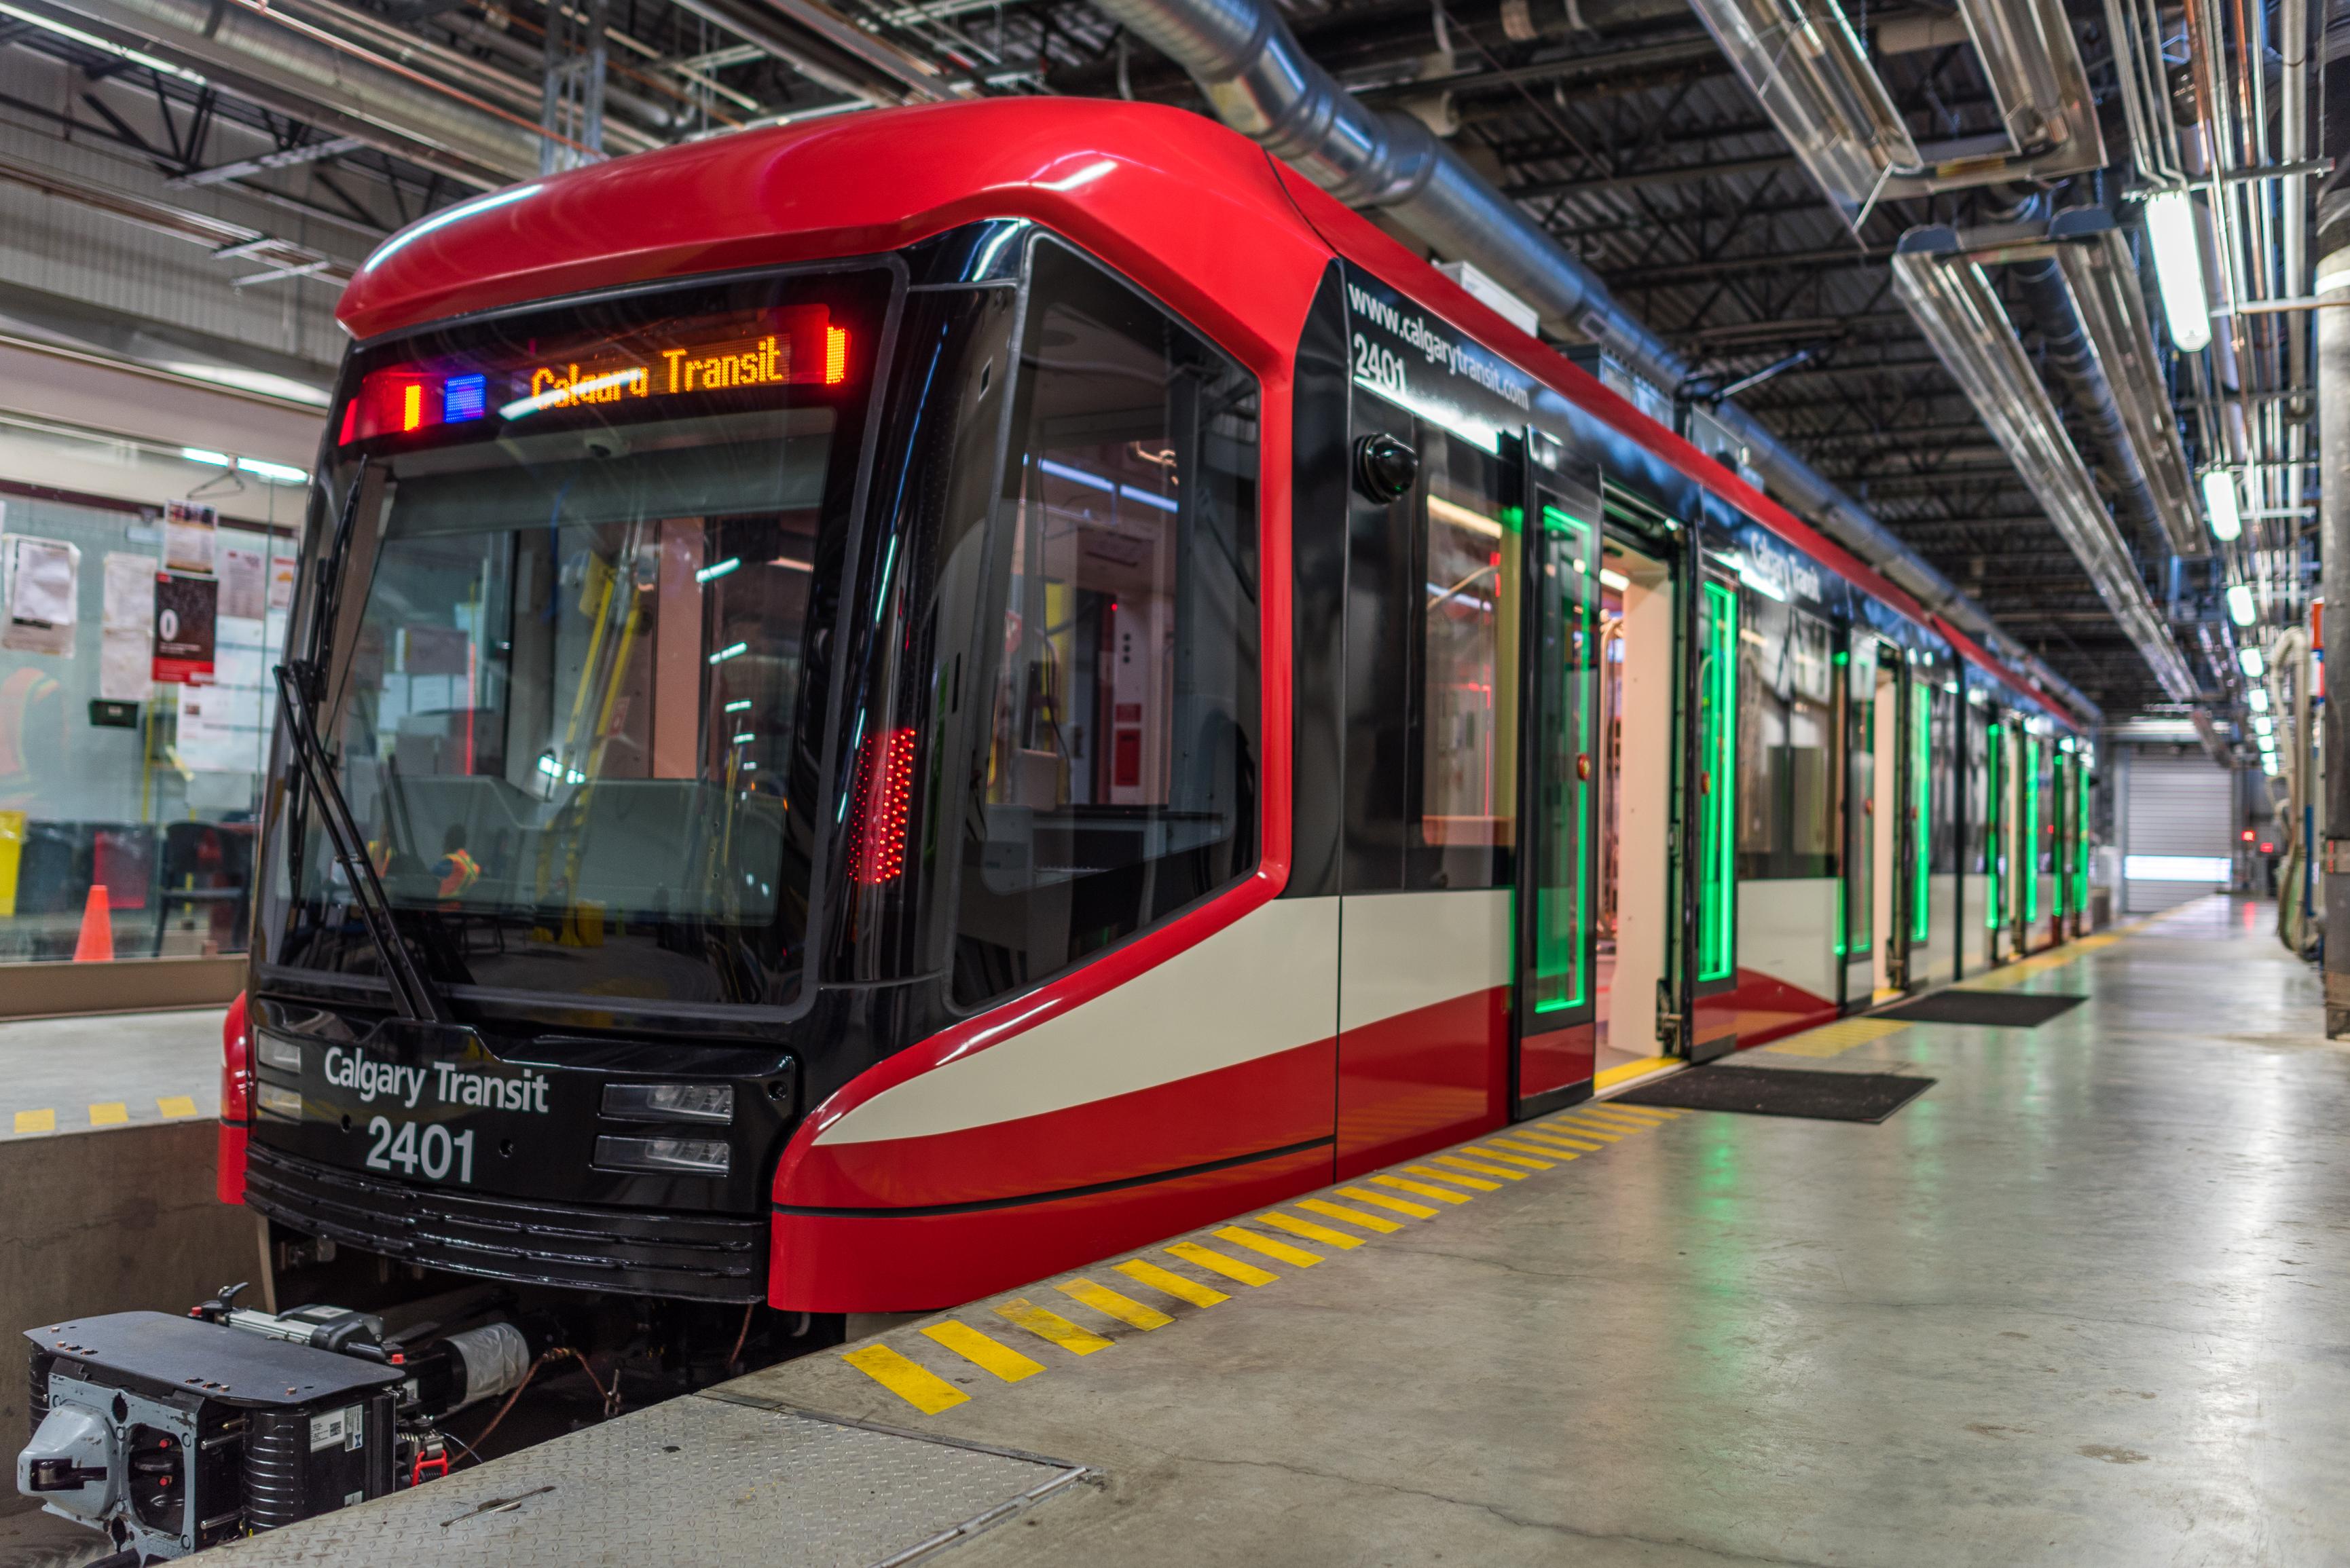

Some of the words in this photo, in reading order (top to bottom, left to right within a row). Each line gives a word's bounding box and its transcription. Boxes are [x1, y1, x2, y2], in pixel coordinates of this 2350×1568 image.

[663, 336, 782, 394] Transit
[1348, 282, 1529, 411] www.calgarytransit.com
[1354, 333, 1406, 396] 2401
[325, 1047, 426, 1108] Calgary
[433, 1061, 549, 1113] Transit
[366, 1115, 475, 1183] 2401
